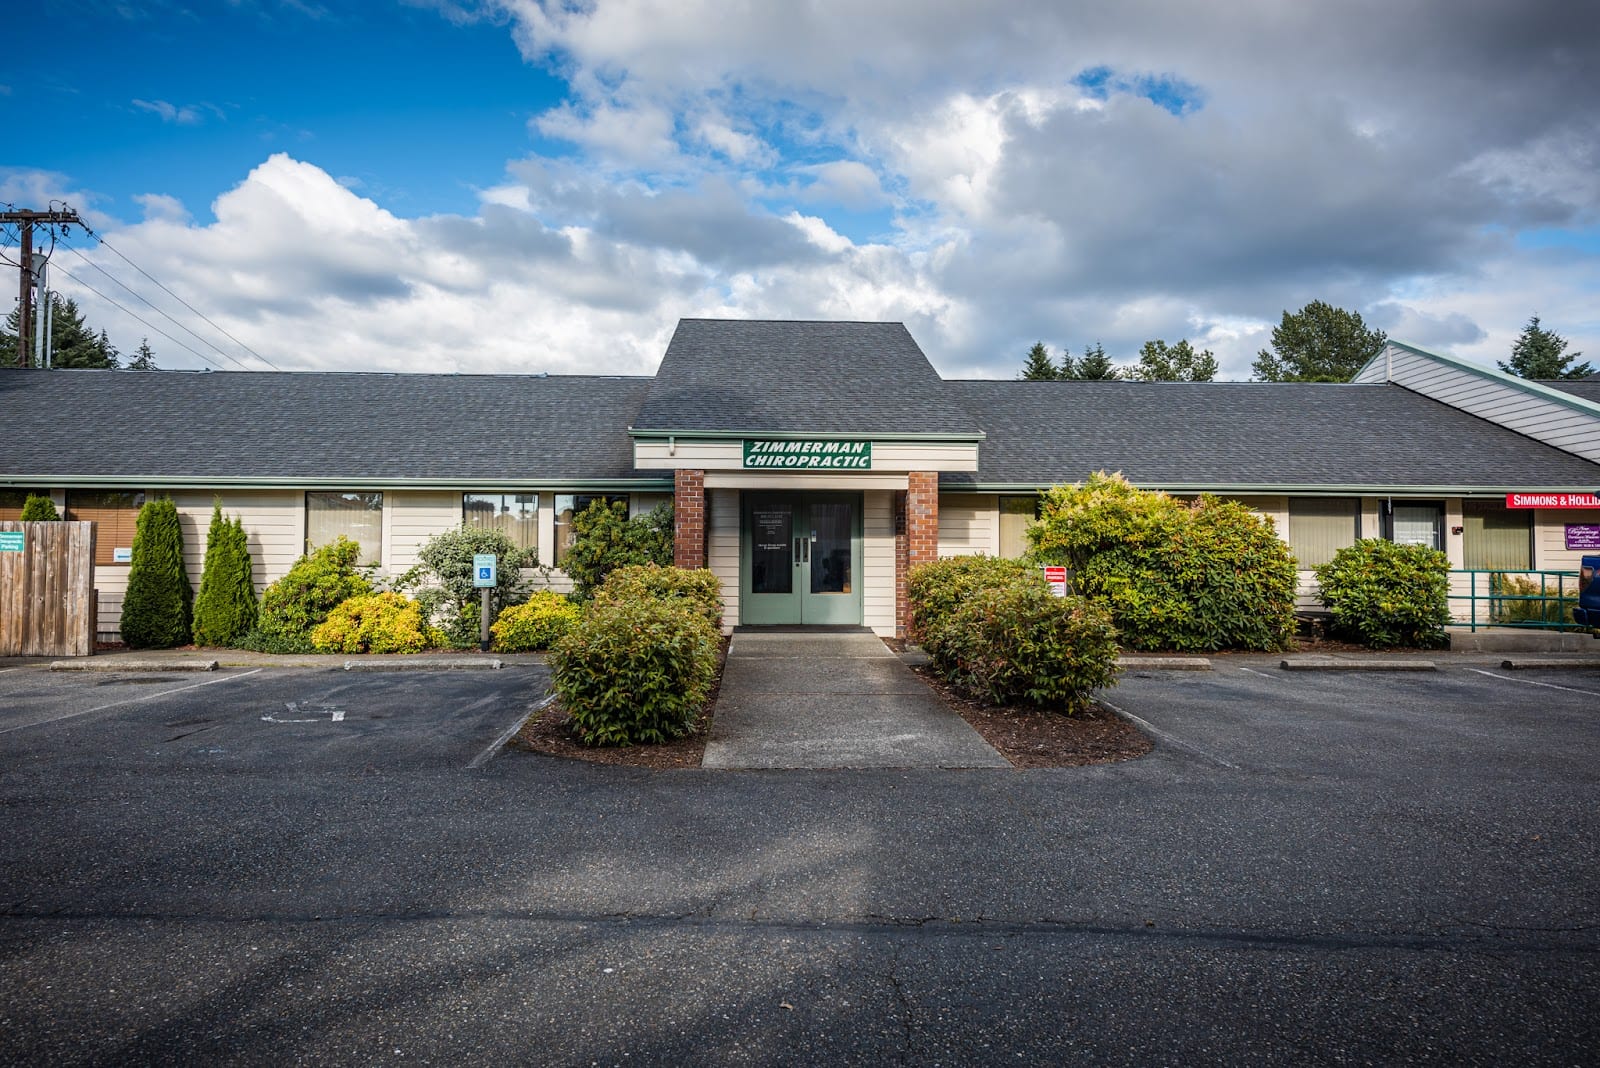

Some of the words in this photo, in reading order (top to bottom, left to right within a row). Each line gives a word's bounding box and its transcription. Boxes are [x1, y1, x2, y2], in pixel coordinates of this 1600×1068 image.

[750, 441, 865, 453] ZIMMERMAN
[745, 455, 870, 467] CHIROPRACTIC
[1513, 494, 1558, 506] SIMMONS
[1559, 496, 1567, 506] &
